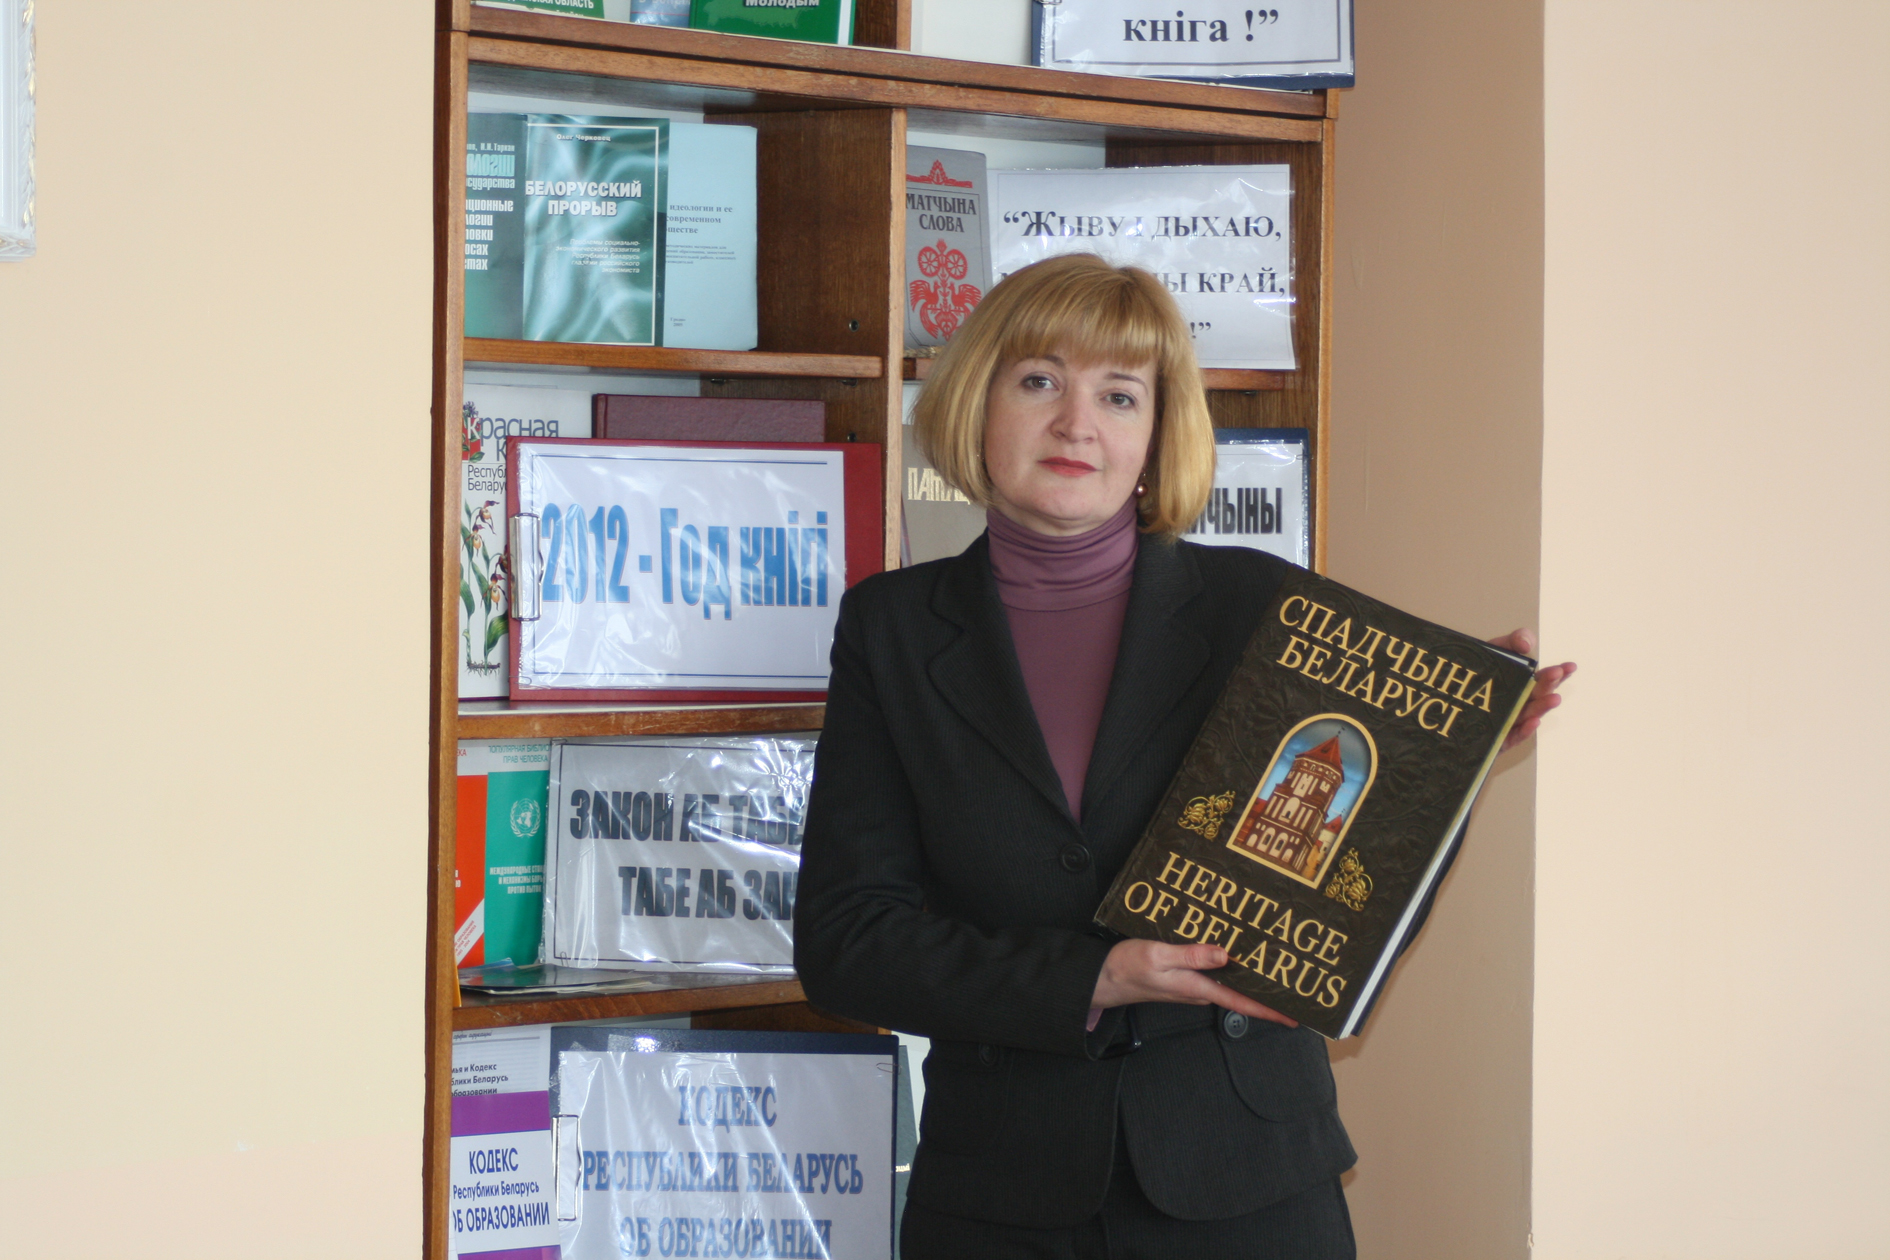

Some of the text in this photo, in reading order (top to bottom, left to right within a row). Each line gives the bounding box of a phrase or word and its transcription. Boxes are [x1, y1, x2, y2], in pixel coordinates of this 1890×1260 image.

[1123, 10, 1229, 42] кніга
[525, 180, 642, 198] БЕЛОРУССКИЙ
[906, 192, 977, 215] МАТЧЫНА
[548, 200, 617, 216] ПРОРЫВ
[919, 213, 965, 233] СЛОВА
[666, 226, 698, 234] ществе
[1151, 215, 1282, 242] ДЫХАЮ,
[1197, 266, 1286, 297] КРАЙ,
[541, 502, 630, 604] 2012
[1279, 595, 1497, 713] СПАДЧЫНА
[1276, 635, 1463, 739] БЕЛАРУСІ
[570, 789, 674, 841] ЗАКОН
[618, 866, 798, 921] ТАБЕ АБ ЗАК
[1155, 851, 1348, 966] HERITAGE
[1124, 881, 1347, 1008] OF BELARUS
[470, 1063, 497, 1073] Кодекс
[473, 1074, 509, 1085] Беларусь
[678, 1085, 777, 1133] КОДЕКС
[469, 1147, 519, 1174] КОДЕКС
[582, 1150, 864, 1195] РЕСПУБЛИКИ БЕЛАРУСЬ
[453, 1181, 539, 1201] Республики Беларусь
[466, 1202, 550, 1232] ОБРАЗОВАНИИ
